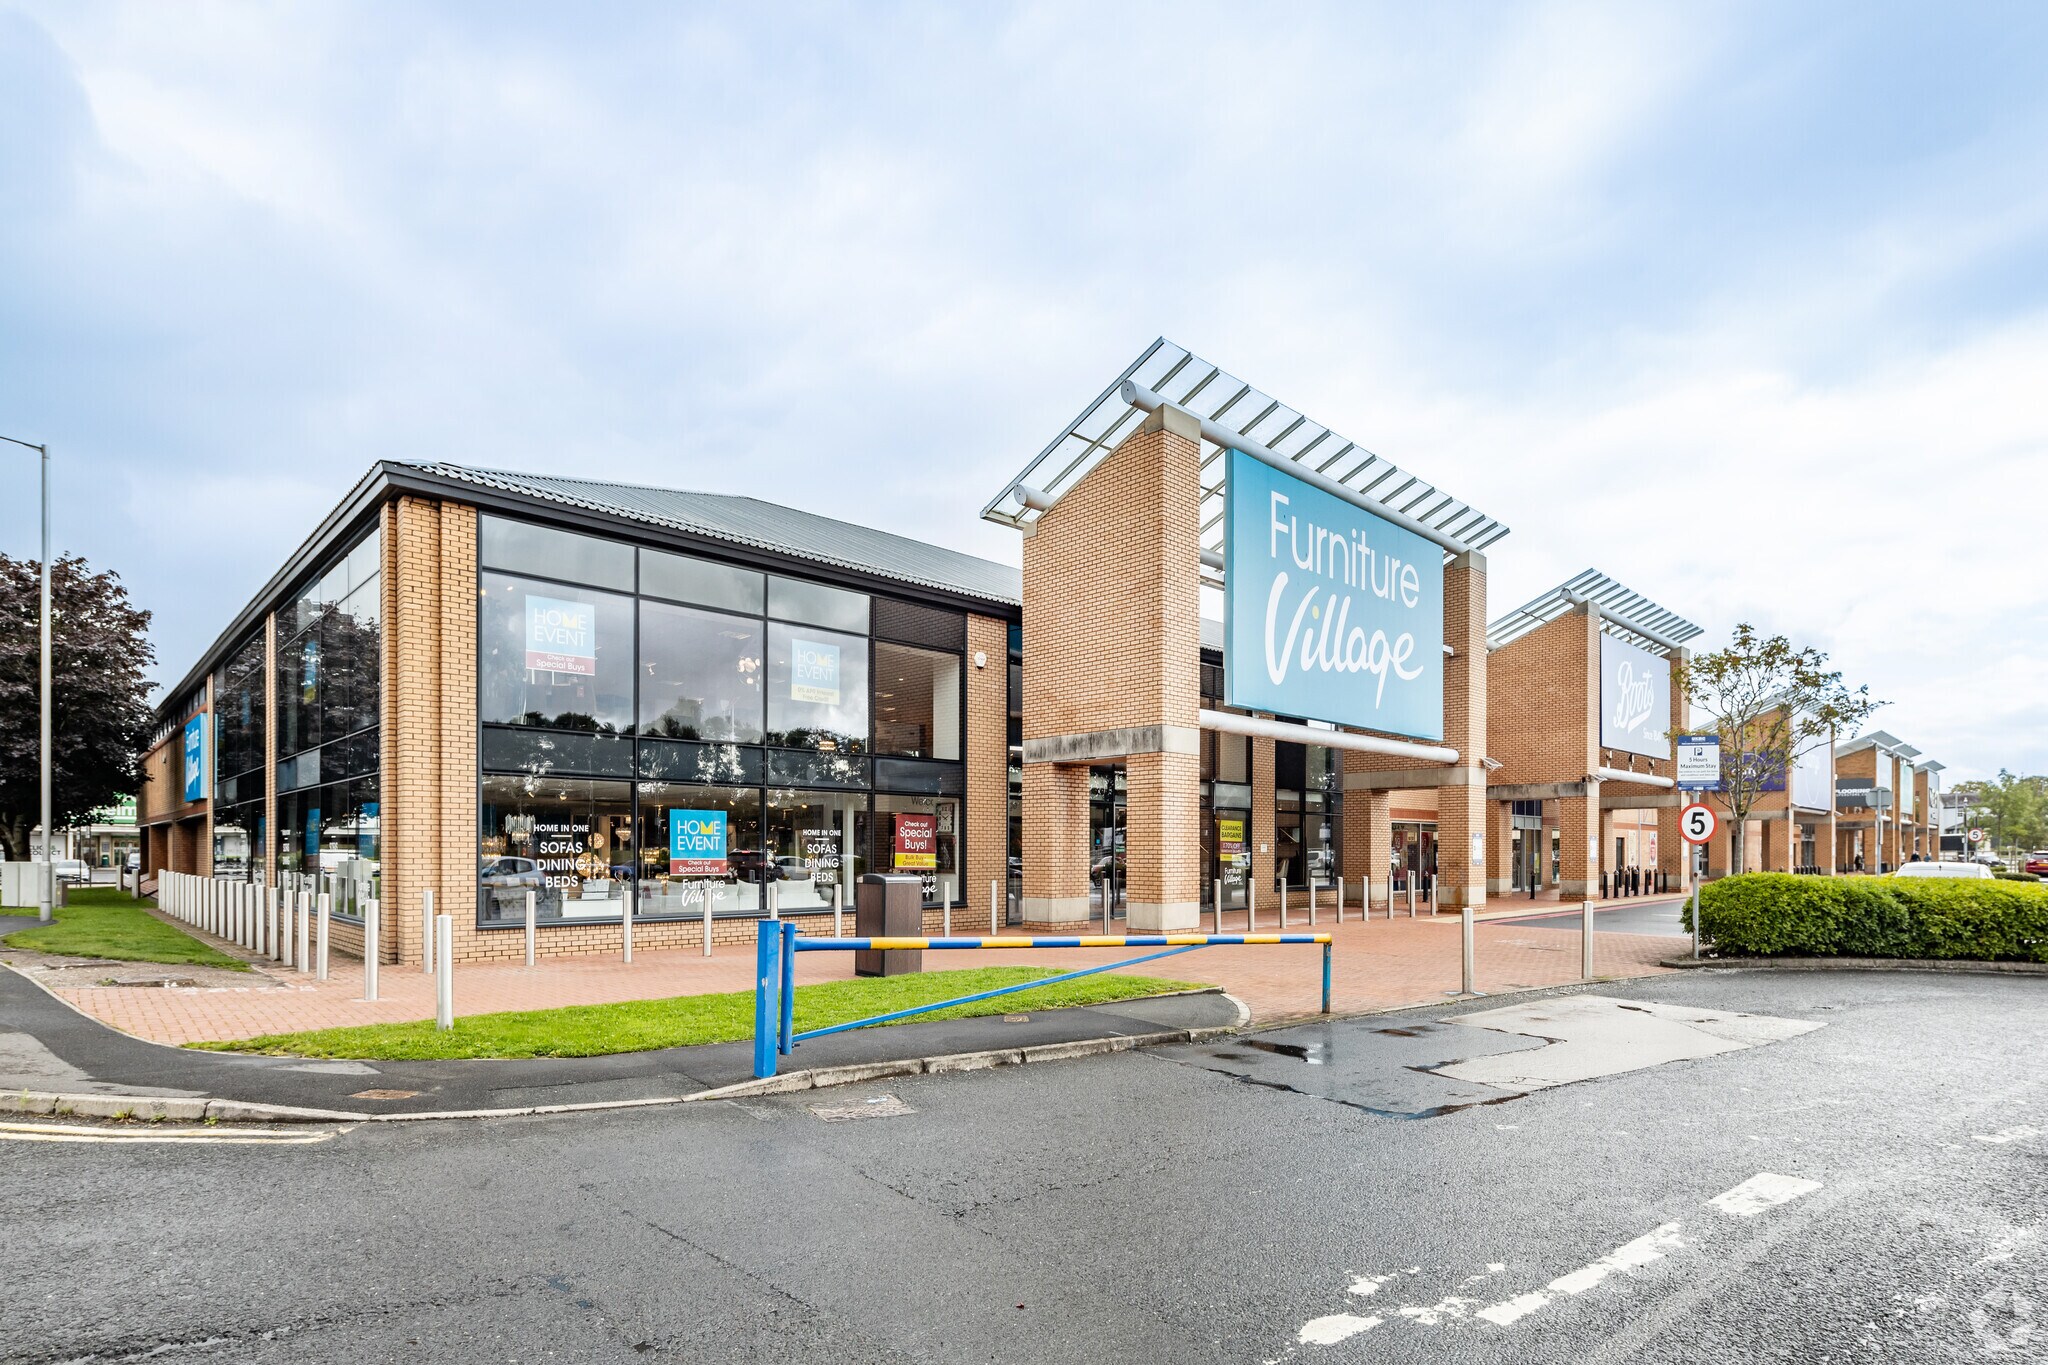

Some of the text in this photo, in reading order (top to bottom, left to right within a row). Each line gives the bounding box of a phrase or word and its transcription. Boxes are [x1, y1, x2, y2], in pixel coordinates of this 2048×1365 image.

[1271, 490, 1420, 608] Furniture
[534, 607, 587, 631] HOME
[534, 625, 587, 647] EVENT
[1265, 571, 1424, 709] Village
[797, 649, 834, 667] HOME
[536, 659, 586, 672] Special Buys
[797, 663, 834, 681] EVENT
[1613, 661, 1655, 734] Boots
[534, 824, 590, 832] HOME IN ONE
[677, 819, 721, 835] HOME
[1690, 811, 1706, 836] 5
[829, 829, 842, 837] ONE
[900, 826, 932, 840] Special
[1972, 831, 1979, 839] 5
[540, 841, 583, 854] SOFAS
[677, 836, 721, 851] EVENT
[807, 843, 837, 854] SOFAS
[904, 839, 927, 852] Buys!
[536, 858, 586, 871] DINING
[678, 865, 720, 873] Special Buys
[804, 858, 840, 868] DINING
[810, 872, 834, 882] BEDS
[1224, 867, 1242, 875] Furniture
[545, 876, 579, 888] BEDS
[682, 879, 726, 890] Furniture
[1223, 874, 1243, 885] Village
